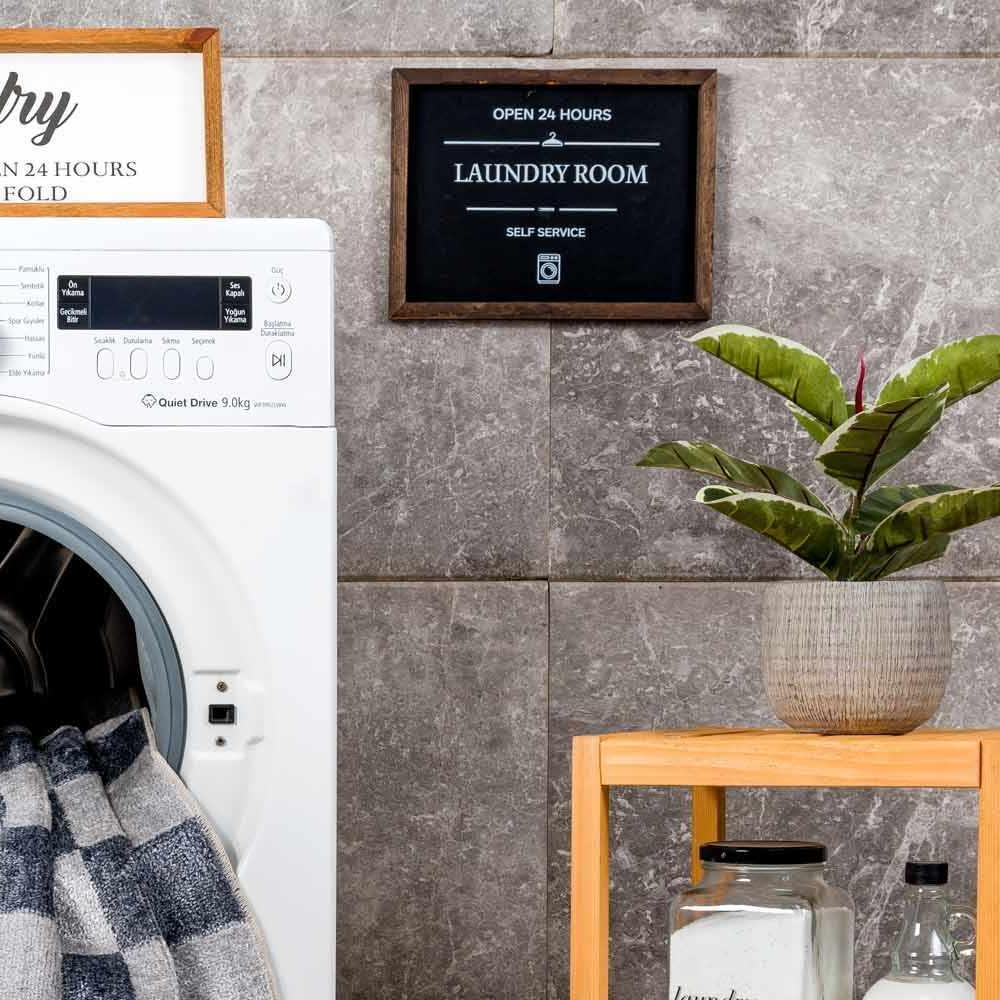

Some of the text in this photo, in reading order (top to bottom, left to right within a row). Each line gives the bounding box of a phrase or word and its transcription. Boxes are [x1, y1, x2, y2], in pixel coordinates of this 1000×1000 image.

[492, 107, 612, 121] OPEN 24 HOURS
[25, 162, 49, 178] 24
[54, 161, 138, 178] HOURS
[453, 162, 649, 184] LAUNDRY ROOM
[3, 185, 68, 202] FOLD
[506, 227, 586, 238] SELF SERVICE
[68, 279, 78, 289] Ön
[229, 281, 241, 289] Ses
[225, 289, 245, 299] Kapalı
[225, 308, 246, 317] Yoğun
[158, 397, 187, 408] Quiet
[190, 397, 218, 408] Drive
[221, 396, 251, 411] 9.0kg
